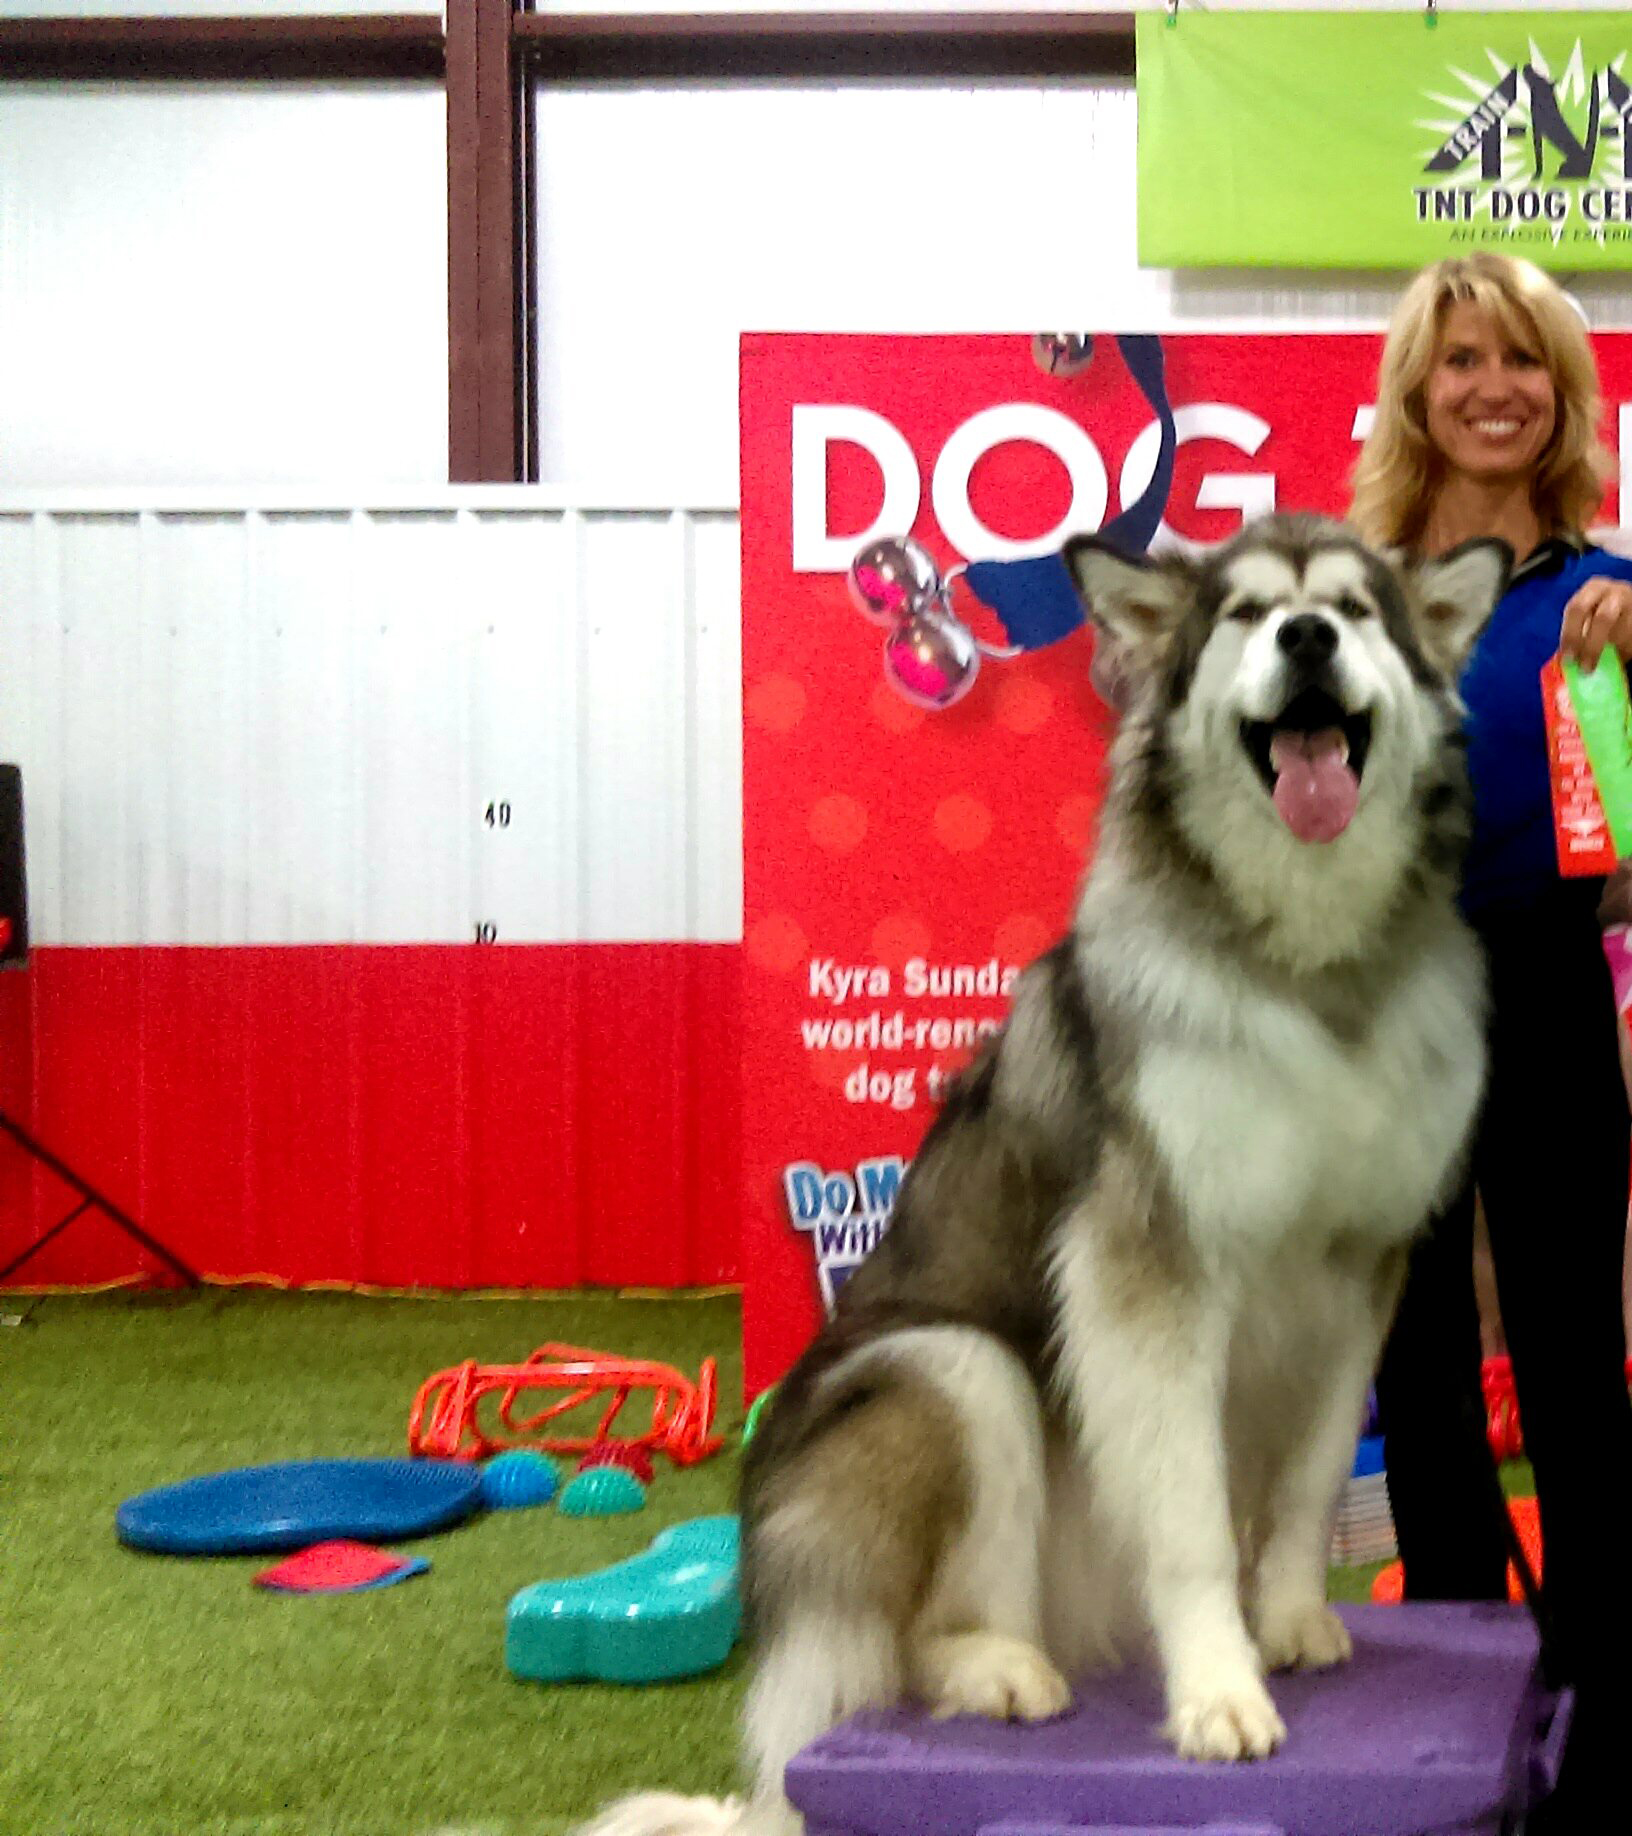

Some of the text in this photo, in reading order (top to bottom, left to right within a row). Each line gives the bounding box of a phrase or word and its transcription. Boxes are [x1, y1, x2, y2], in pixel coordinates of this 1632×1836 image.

[1443, 93, 1510, 161] TRAIN
[1413, 187, 1478, 222] TNT
[1490, 187, 1568, 222] DOG
[1449, 227, 1476, 243] AN
[1481, 226, 1567, 243] EXPLOSIVE
[791, 400, 1277, 573] DOG
[484, 801, 511, 828] 40
[808, 957, 890, 1005] Kyra
[844, 1063, 916, 1110] dog
[785, 1160, 854, 1230] Do
